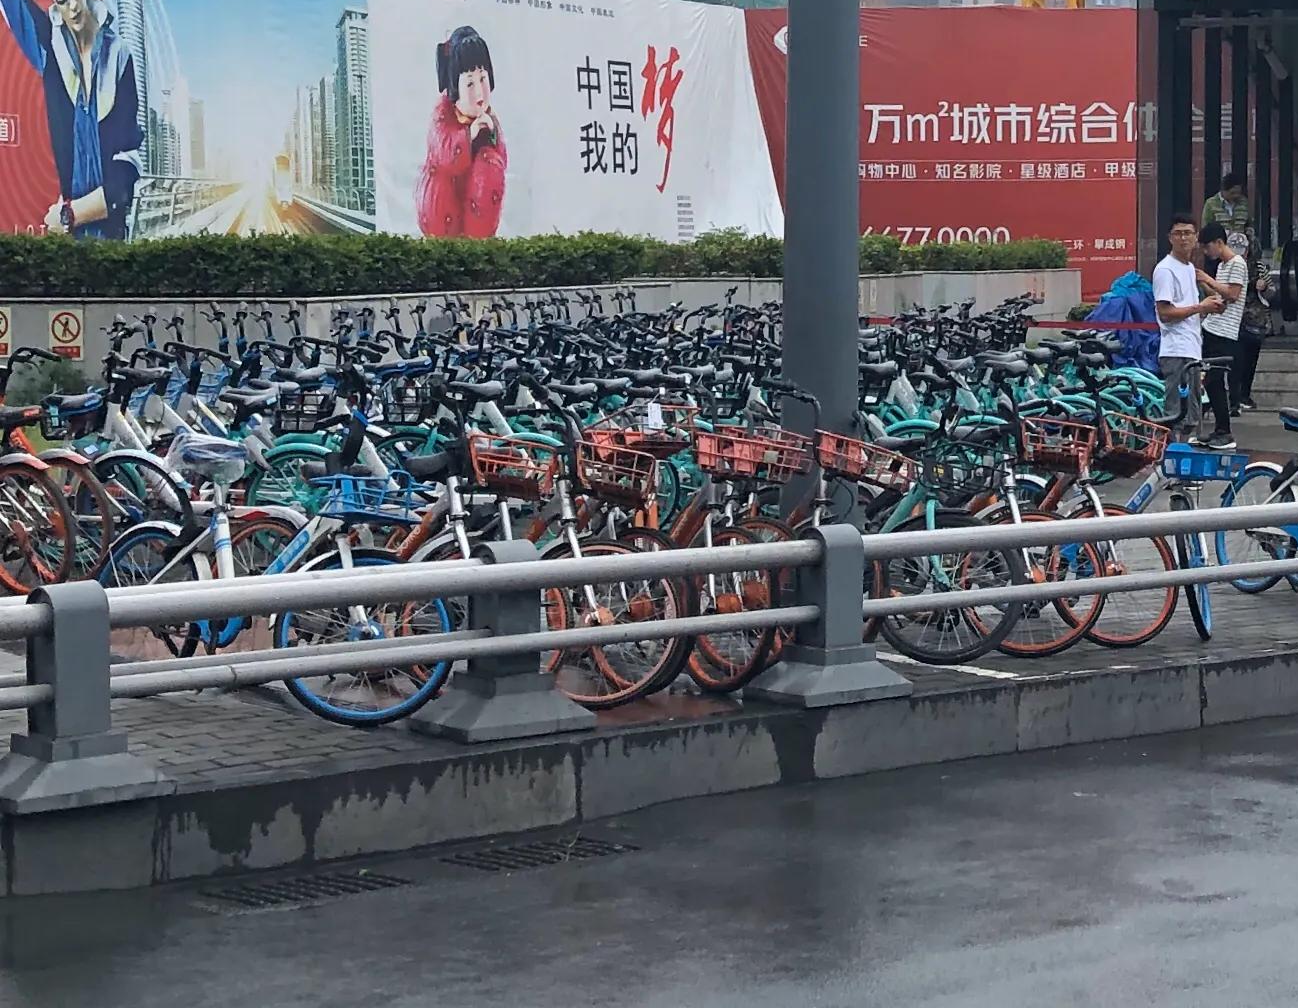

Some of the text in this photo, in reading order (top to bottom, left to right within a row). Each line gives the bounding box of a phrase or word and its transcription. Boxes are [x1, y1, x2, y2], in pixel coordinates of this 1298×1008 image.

[577, 55, 635, 114] 中国
[580, 120, 640, 176] 我的
[935, 163, 1002, 180] 知名影院
[1019, 163, 1087, 180] 星级酒店
